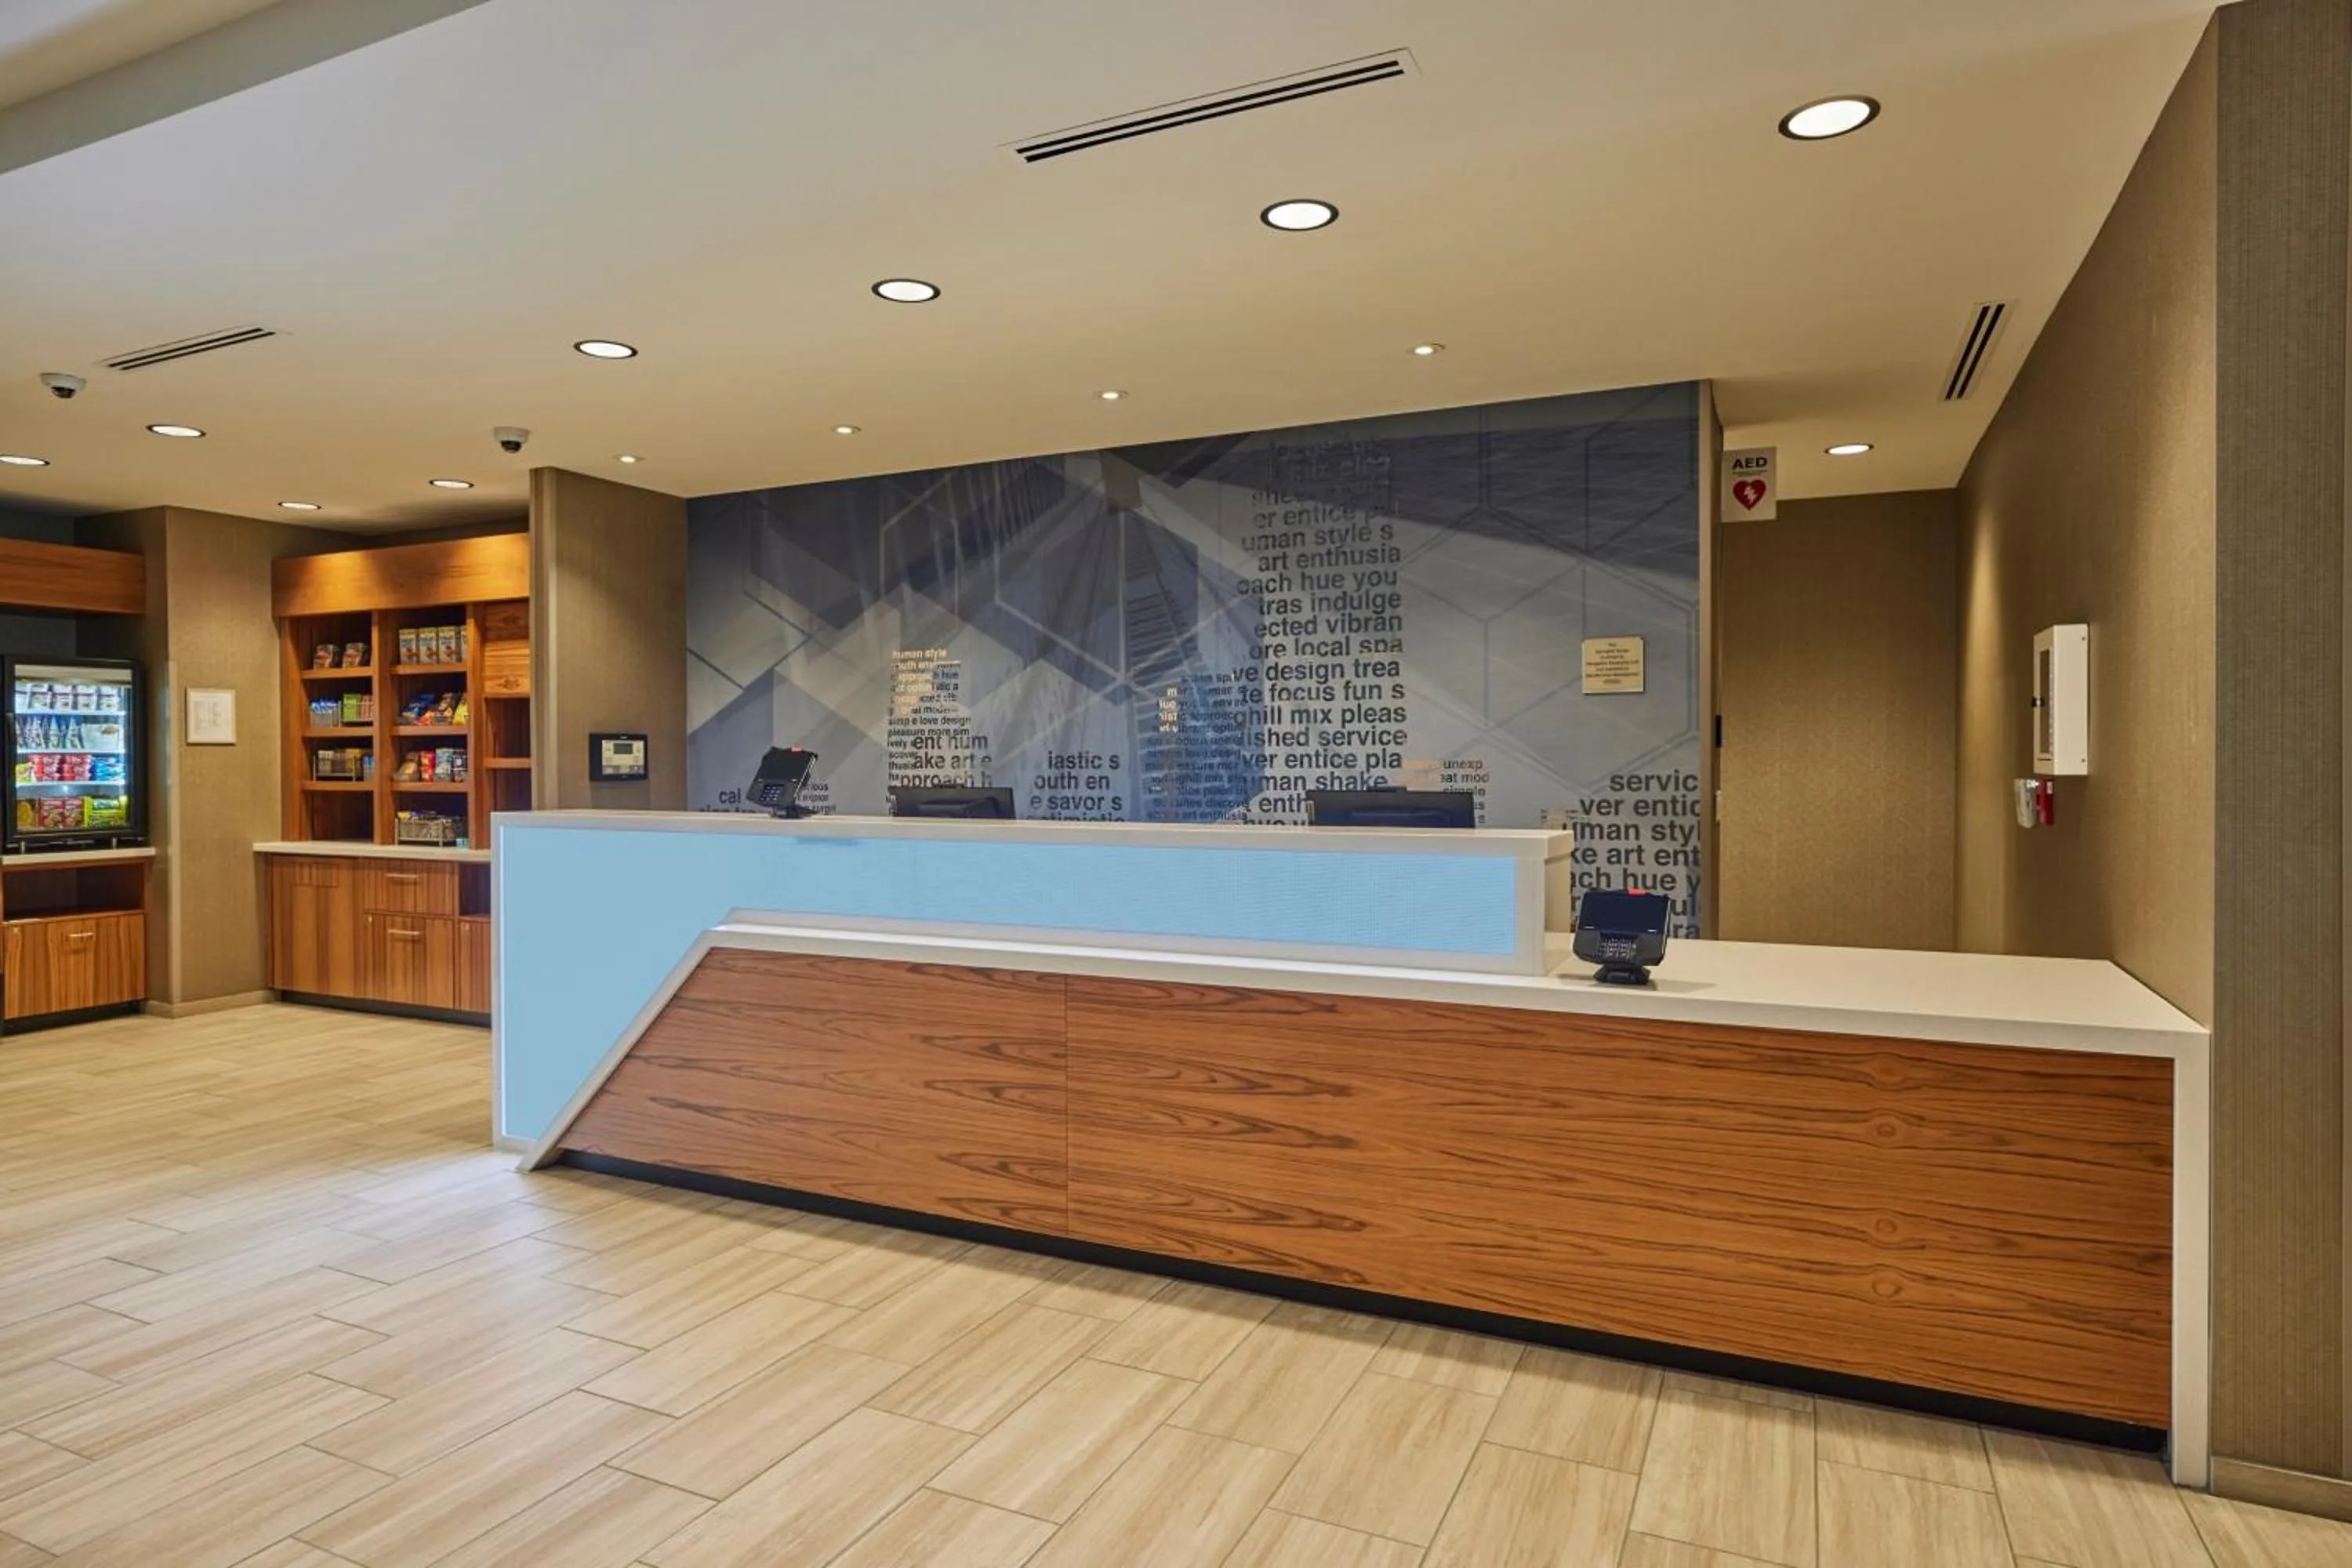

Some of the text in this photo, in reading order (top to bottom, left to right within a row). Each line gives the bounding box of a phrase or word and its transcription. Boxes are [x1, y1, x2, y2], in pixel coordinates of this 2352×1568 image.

[1732, 457, 1767, 470] AED
[1241, 524, 1393, 553] uman style s
[1258, 543, 1401, 572] art enthusia
[1301, 571, 1345, 592] hue
[1352, 569, 1398, 592] you
[1258, 590, 1402, 615] tras indulge
[1254, 612, 1403, 638] ected vibran
[1249, 643, 1287, 660] ore
[1294, 635, 1351, 657] local
[1265, 661, 1345, 684] design
[1352, 659, 1400, 678] trea
[1269, 682, 1336, 702] focus
[1343, 680, 1383, 701] fun
[1391, 683, 1406, 699] s
[1290, 708, 1334, 724] mix
[1341, 702, 1407, 728] pleas
[1316, 725, 1407, 746] service
[913, 752, 946, 770] ake
[1047, 750, 1120, 771] iastic s
[1241, 753, 1276, 769] ver
[1284, 747, 1359, 769] entice
[1365, 747, 1403, 773] pla
[1443, 759, 1483, 773] unexp
[1033, 771, 1111, 791] outh en
[1315, 770, 1389, 791] shake
[1609, 768, 1699, 793] servic
[718, 787, 742, 804] cal
[1045, 794, 1105, 811] savor
[1109, 795, 1123, 812] s
[1579, 797, 1625, 817] ver
[1606, 844, 1646, 866] art
[1653, 844, 1700, 867] ent
[1621, 867, 1678, 891] hue
